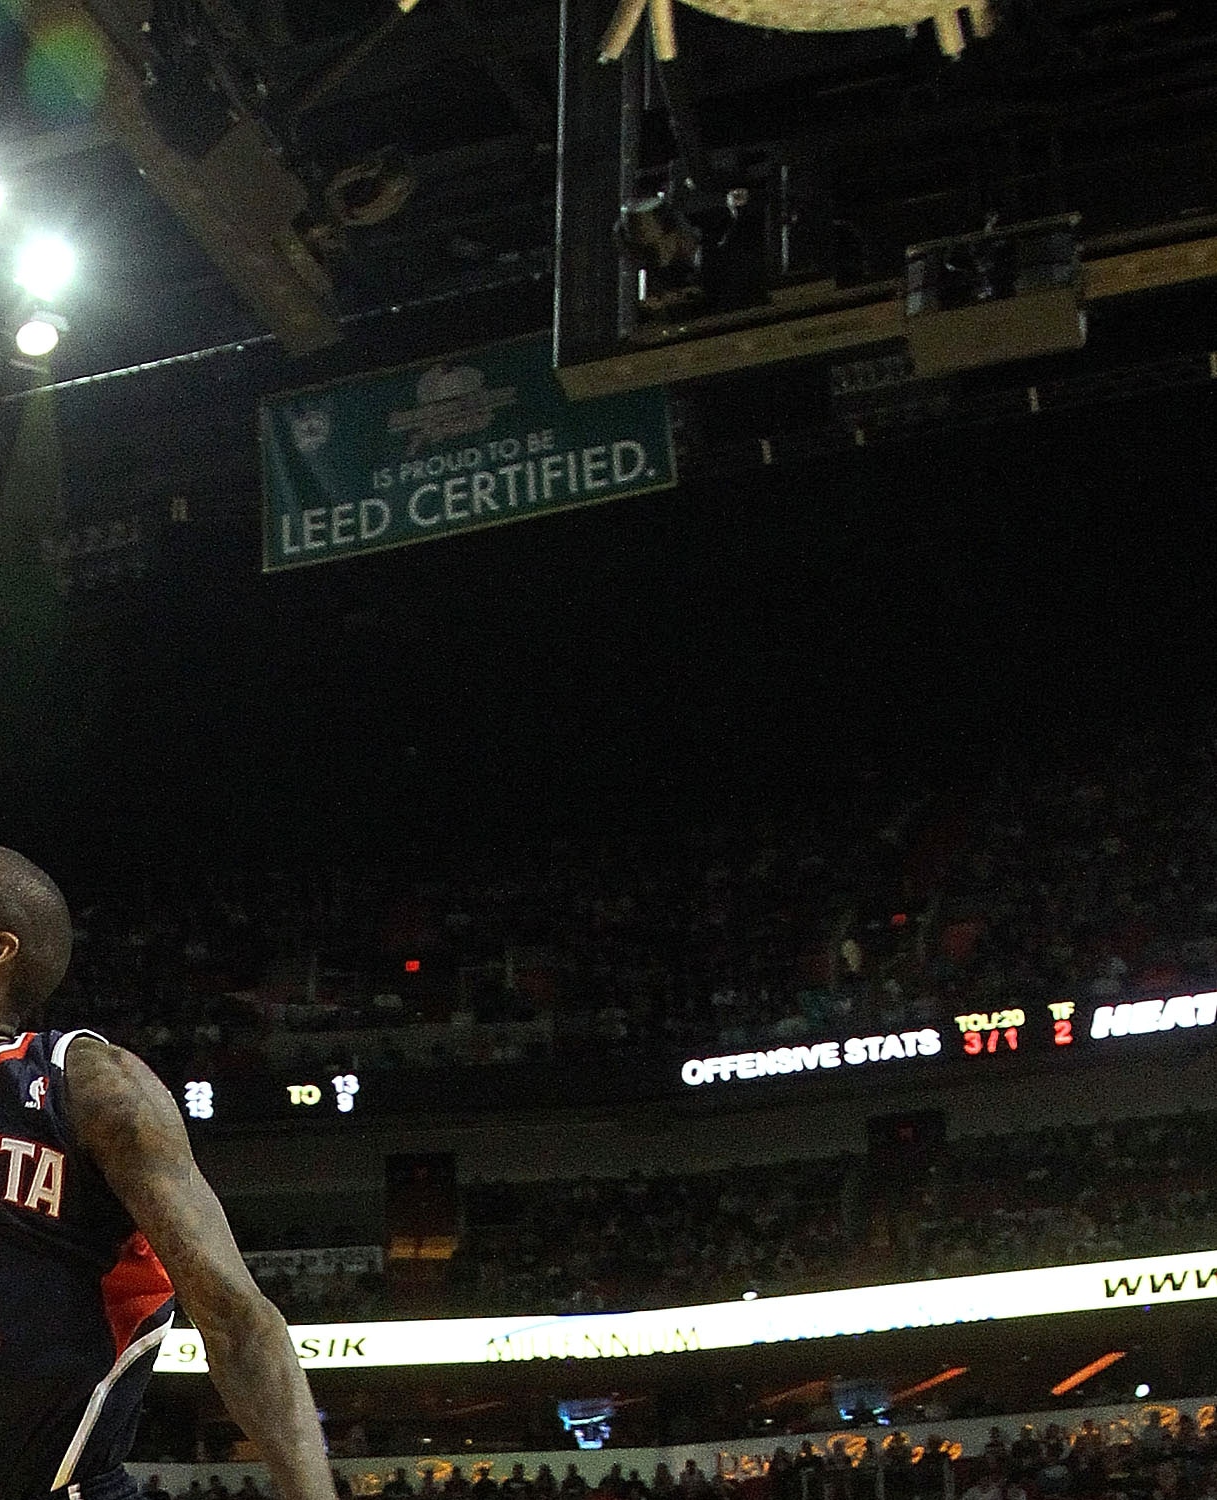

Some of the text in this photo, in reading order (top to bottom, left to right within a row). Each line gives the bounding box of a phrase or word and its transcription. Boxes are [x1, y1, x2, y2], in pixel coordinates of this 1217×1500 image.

[374, 429, 555, 488] IS PROUD TO BE
[281, 439, 656, 554] LEED CERTIFIED.
[1048, 1001, 1075, 1021] TF
[1054, 1019, 1074, 1047] 2
[681, 1028, 942, 1086] OFFENSIVE STATS
[286, 1084, 322, 1105] TO
[298, 1336, 367, 1360] SIK
